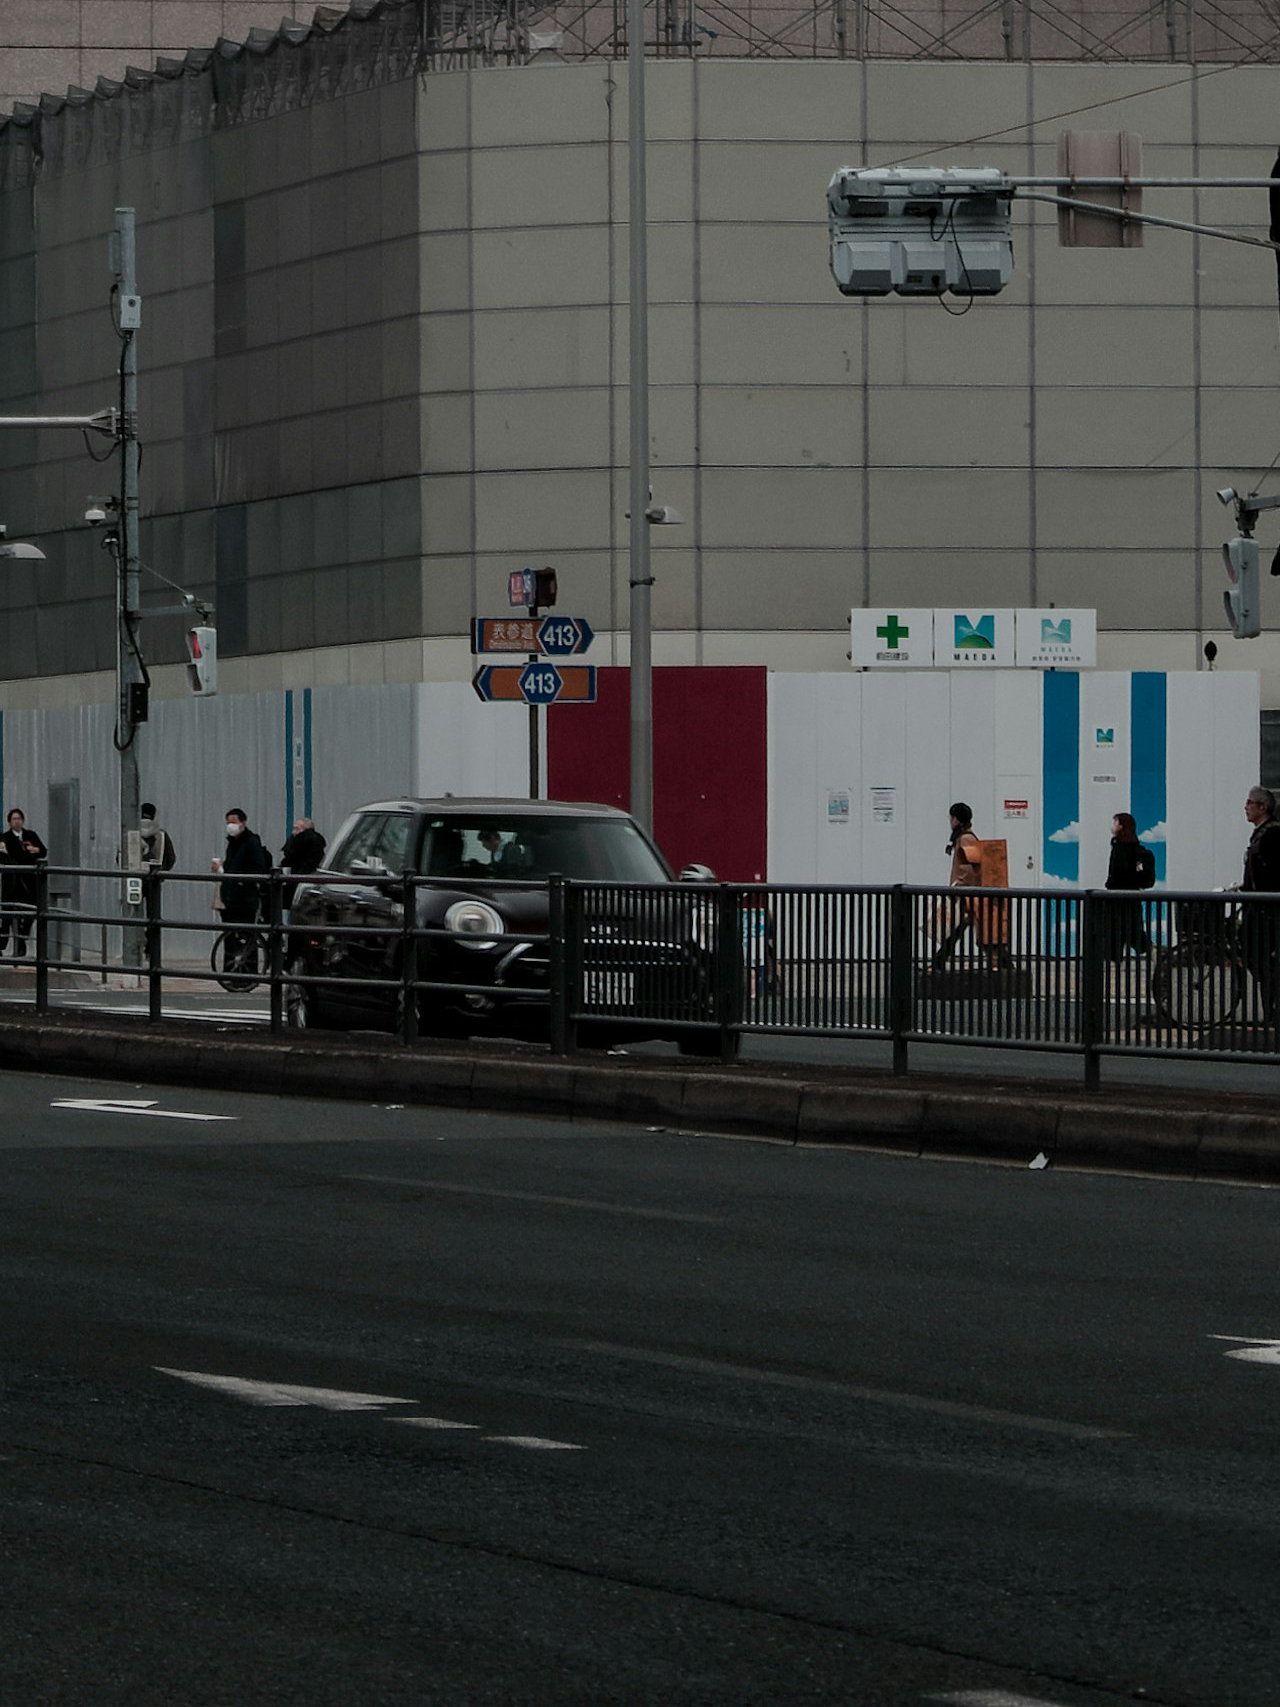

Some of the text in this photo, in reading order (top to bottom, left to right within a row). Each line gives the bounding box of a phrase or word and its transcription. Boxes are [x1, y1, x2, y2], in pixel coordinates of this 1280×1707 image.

[493, 623, 534, 640] 表参道
[544, 625, 574, 646] 413
[953, 653, 996, 661] MAEDA
[524, 672, 555, 694] 413
